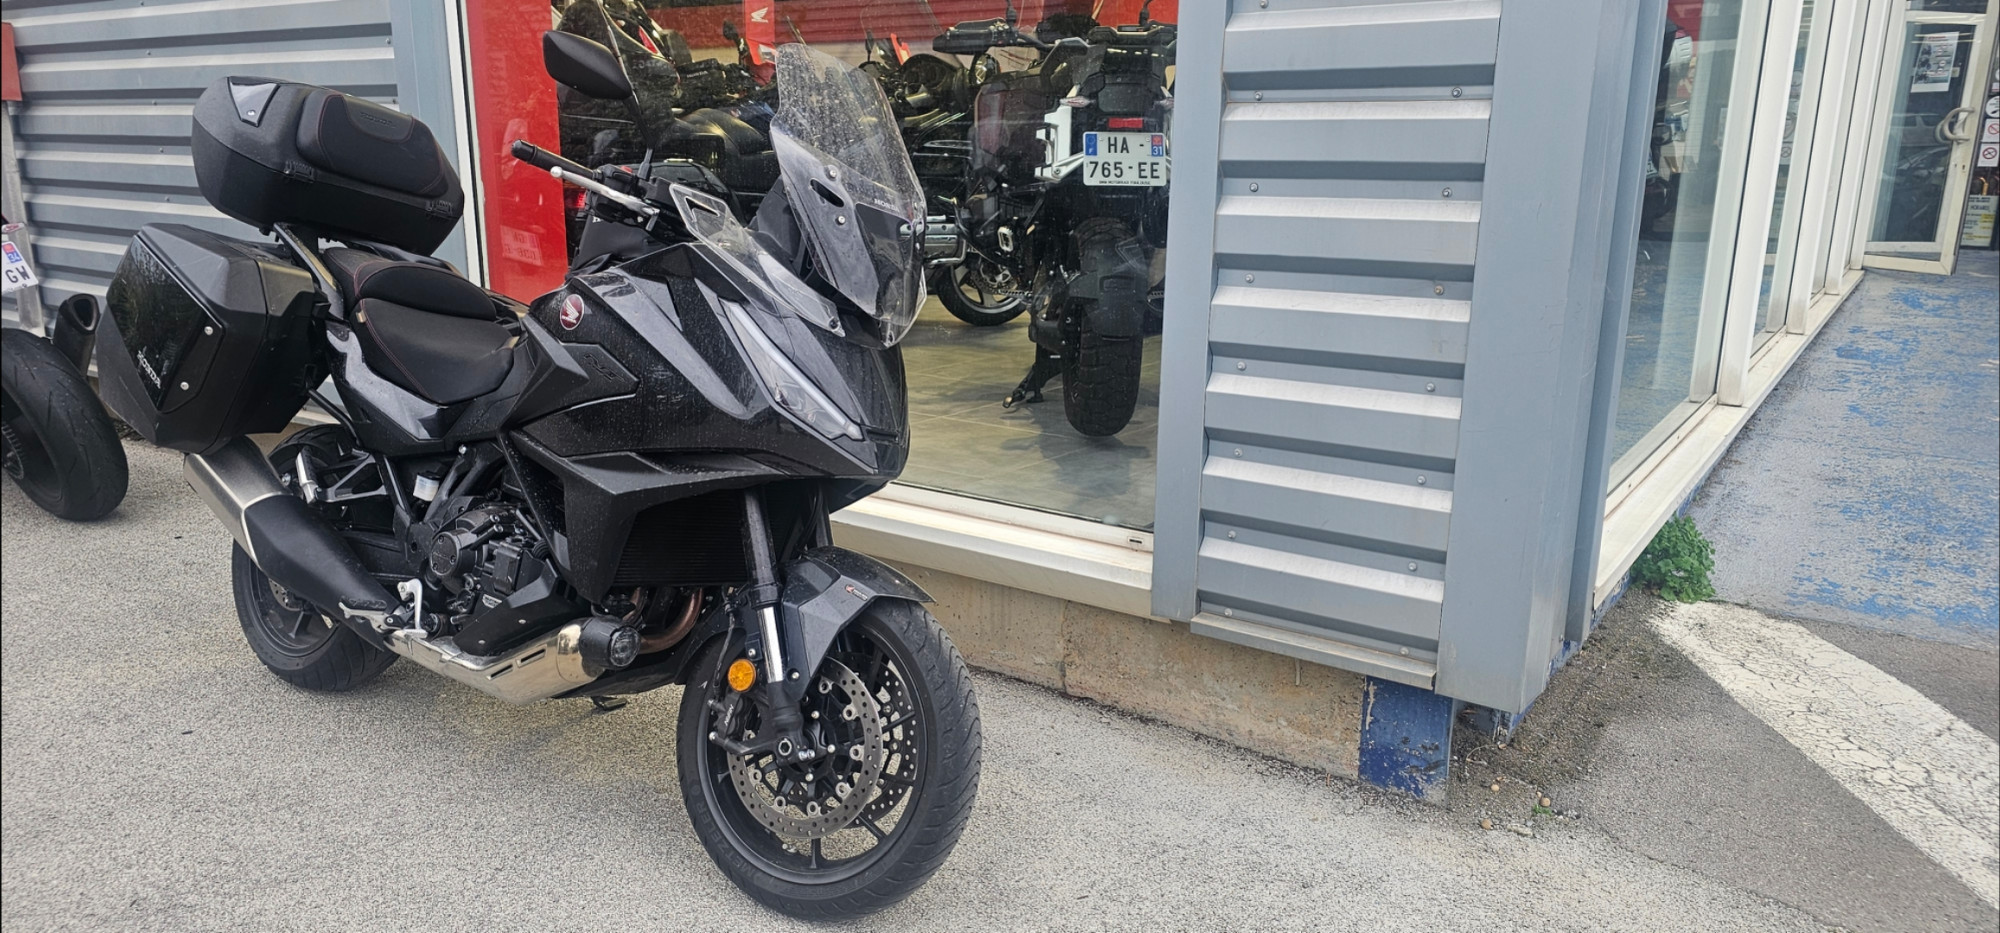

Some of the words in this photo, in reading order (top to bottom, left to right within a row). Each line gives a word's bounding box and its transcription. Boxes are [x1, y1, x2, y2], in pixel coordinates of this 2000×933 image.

[1152, 146, 1163, 155] 31
[1089, 161, 1160, 178] 765-EE
[874, 198, 900, 212] HONDA
[5, 265, 31, 284] GW
[137, 350, 161, 389] HONDA
